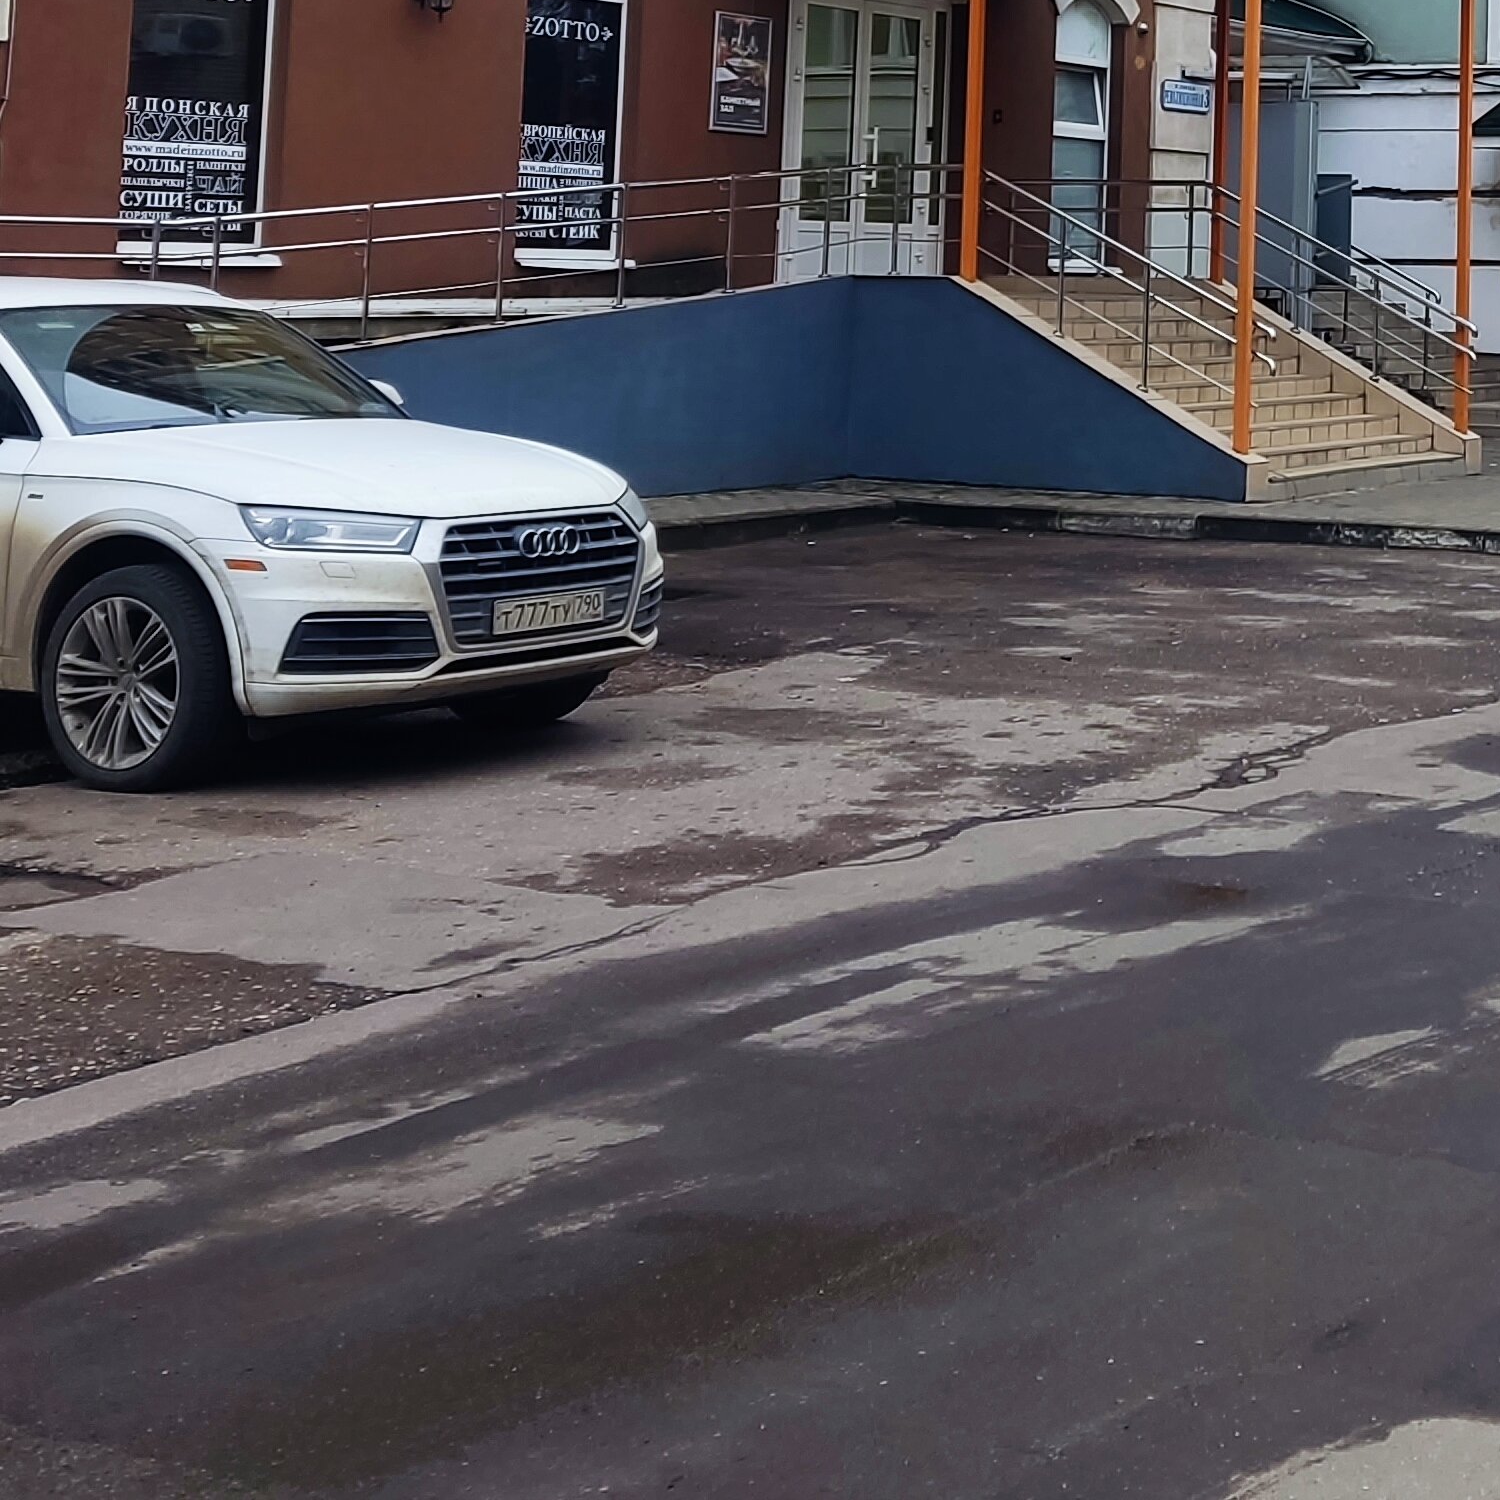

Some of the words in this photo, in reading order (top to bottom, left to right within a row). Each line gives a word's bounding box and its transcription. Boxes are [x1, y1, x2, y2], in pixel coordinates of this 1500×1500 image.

[532, 16, 600, 41] ZOTTO
[123, 111, 247, 145] КУХНЯ
[122, 158, 186, 173] РОЛЛЫ
[196, 161, 246, 171] НАПИТКИ
[194, 173, 246, 196] ЧАЙ
[119, 190, 184, 208] СУШИ
[194, 199, 243, 213] СЕТЫ
[564, 206, 601, 219] ПАСТА
[576, 593, 601, 614] 790
